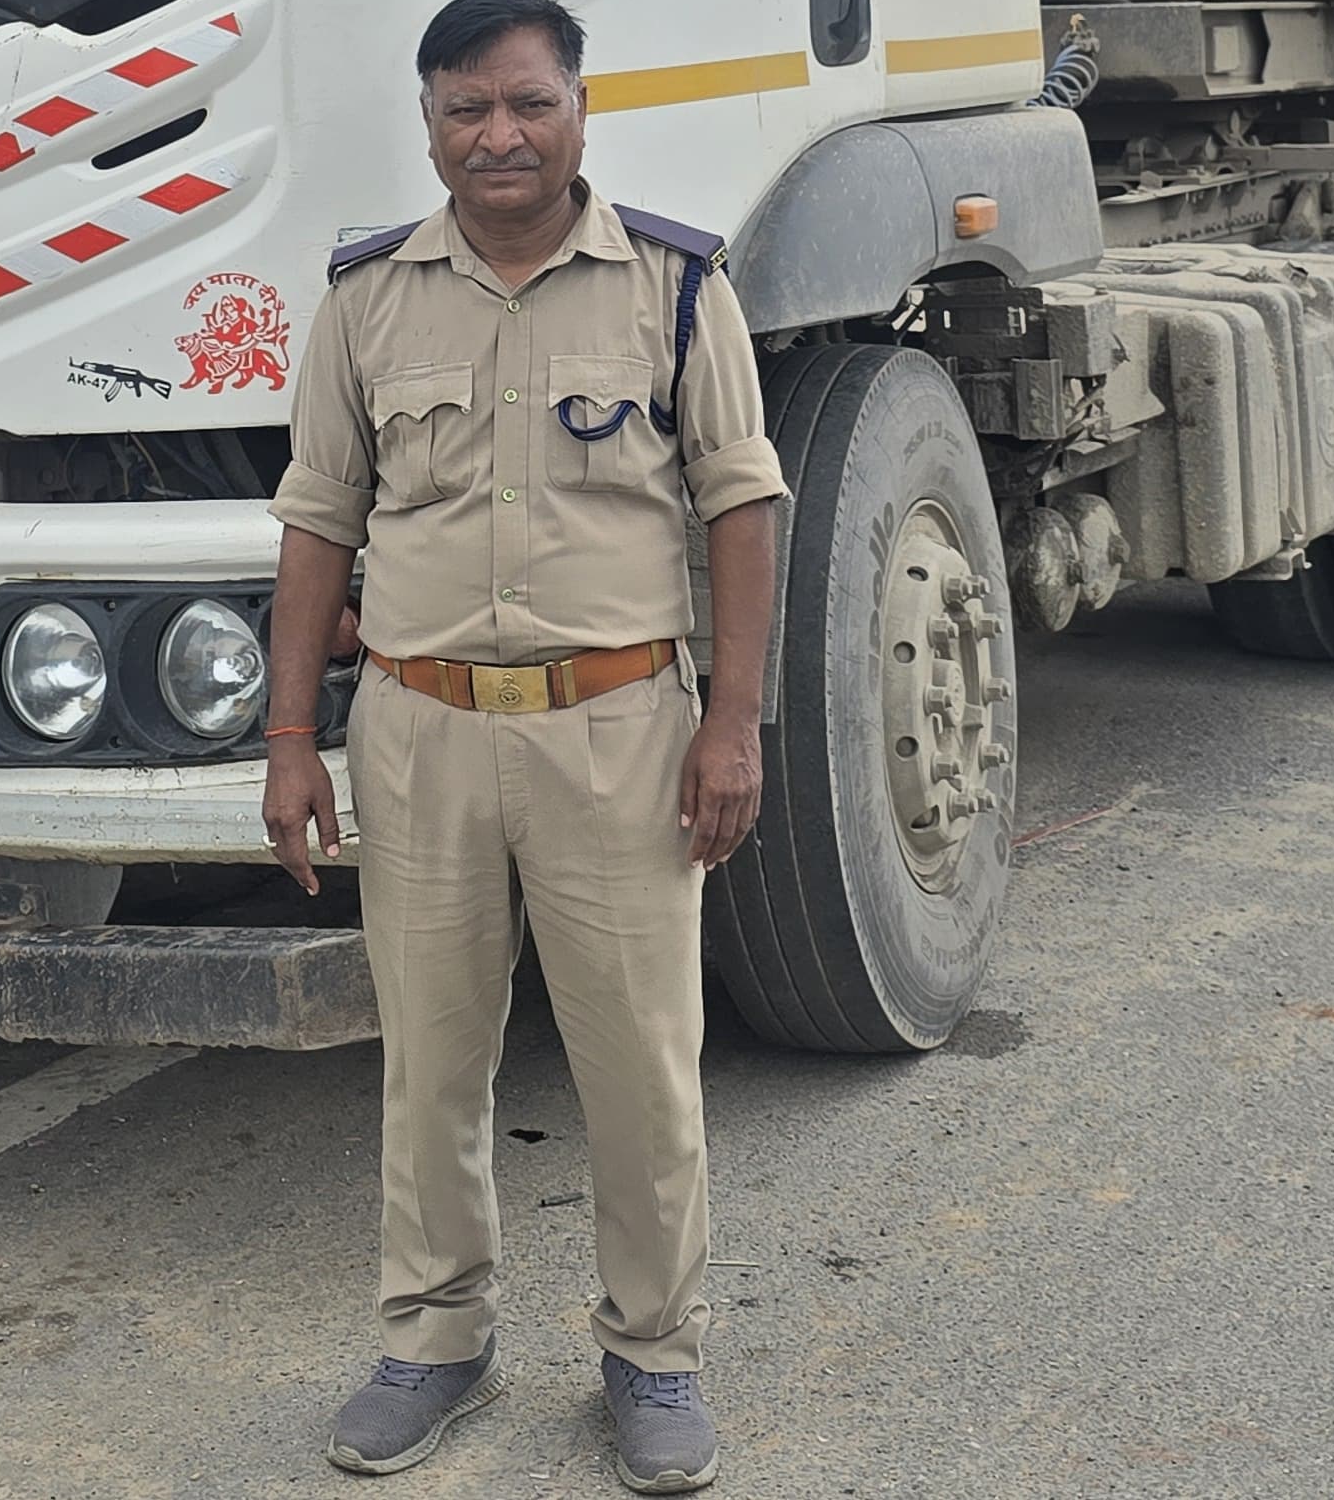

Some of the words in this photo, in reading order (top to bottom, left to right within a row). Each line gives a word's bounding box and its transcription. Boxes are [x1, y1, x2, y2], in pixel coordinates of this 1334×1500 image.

[183, 281, 208, 309] जय
[206, 273, 260, 290] माता
[67, 373, 109, 391] AK-47
[868, 502, 895, 695] apollo
